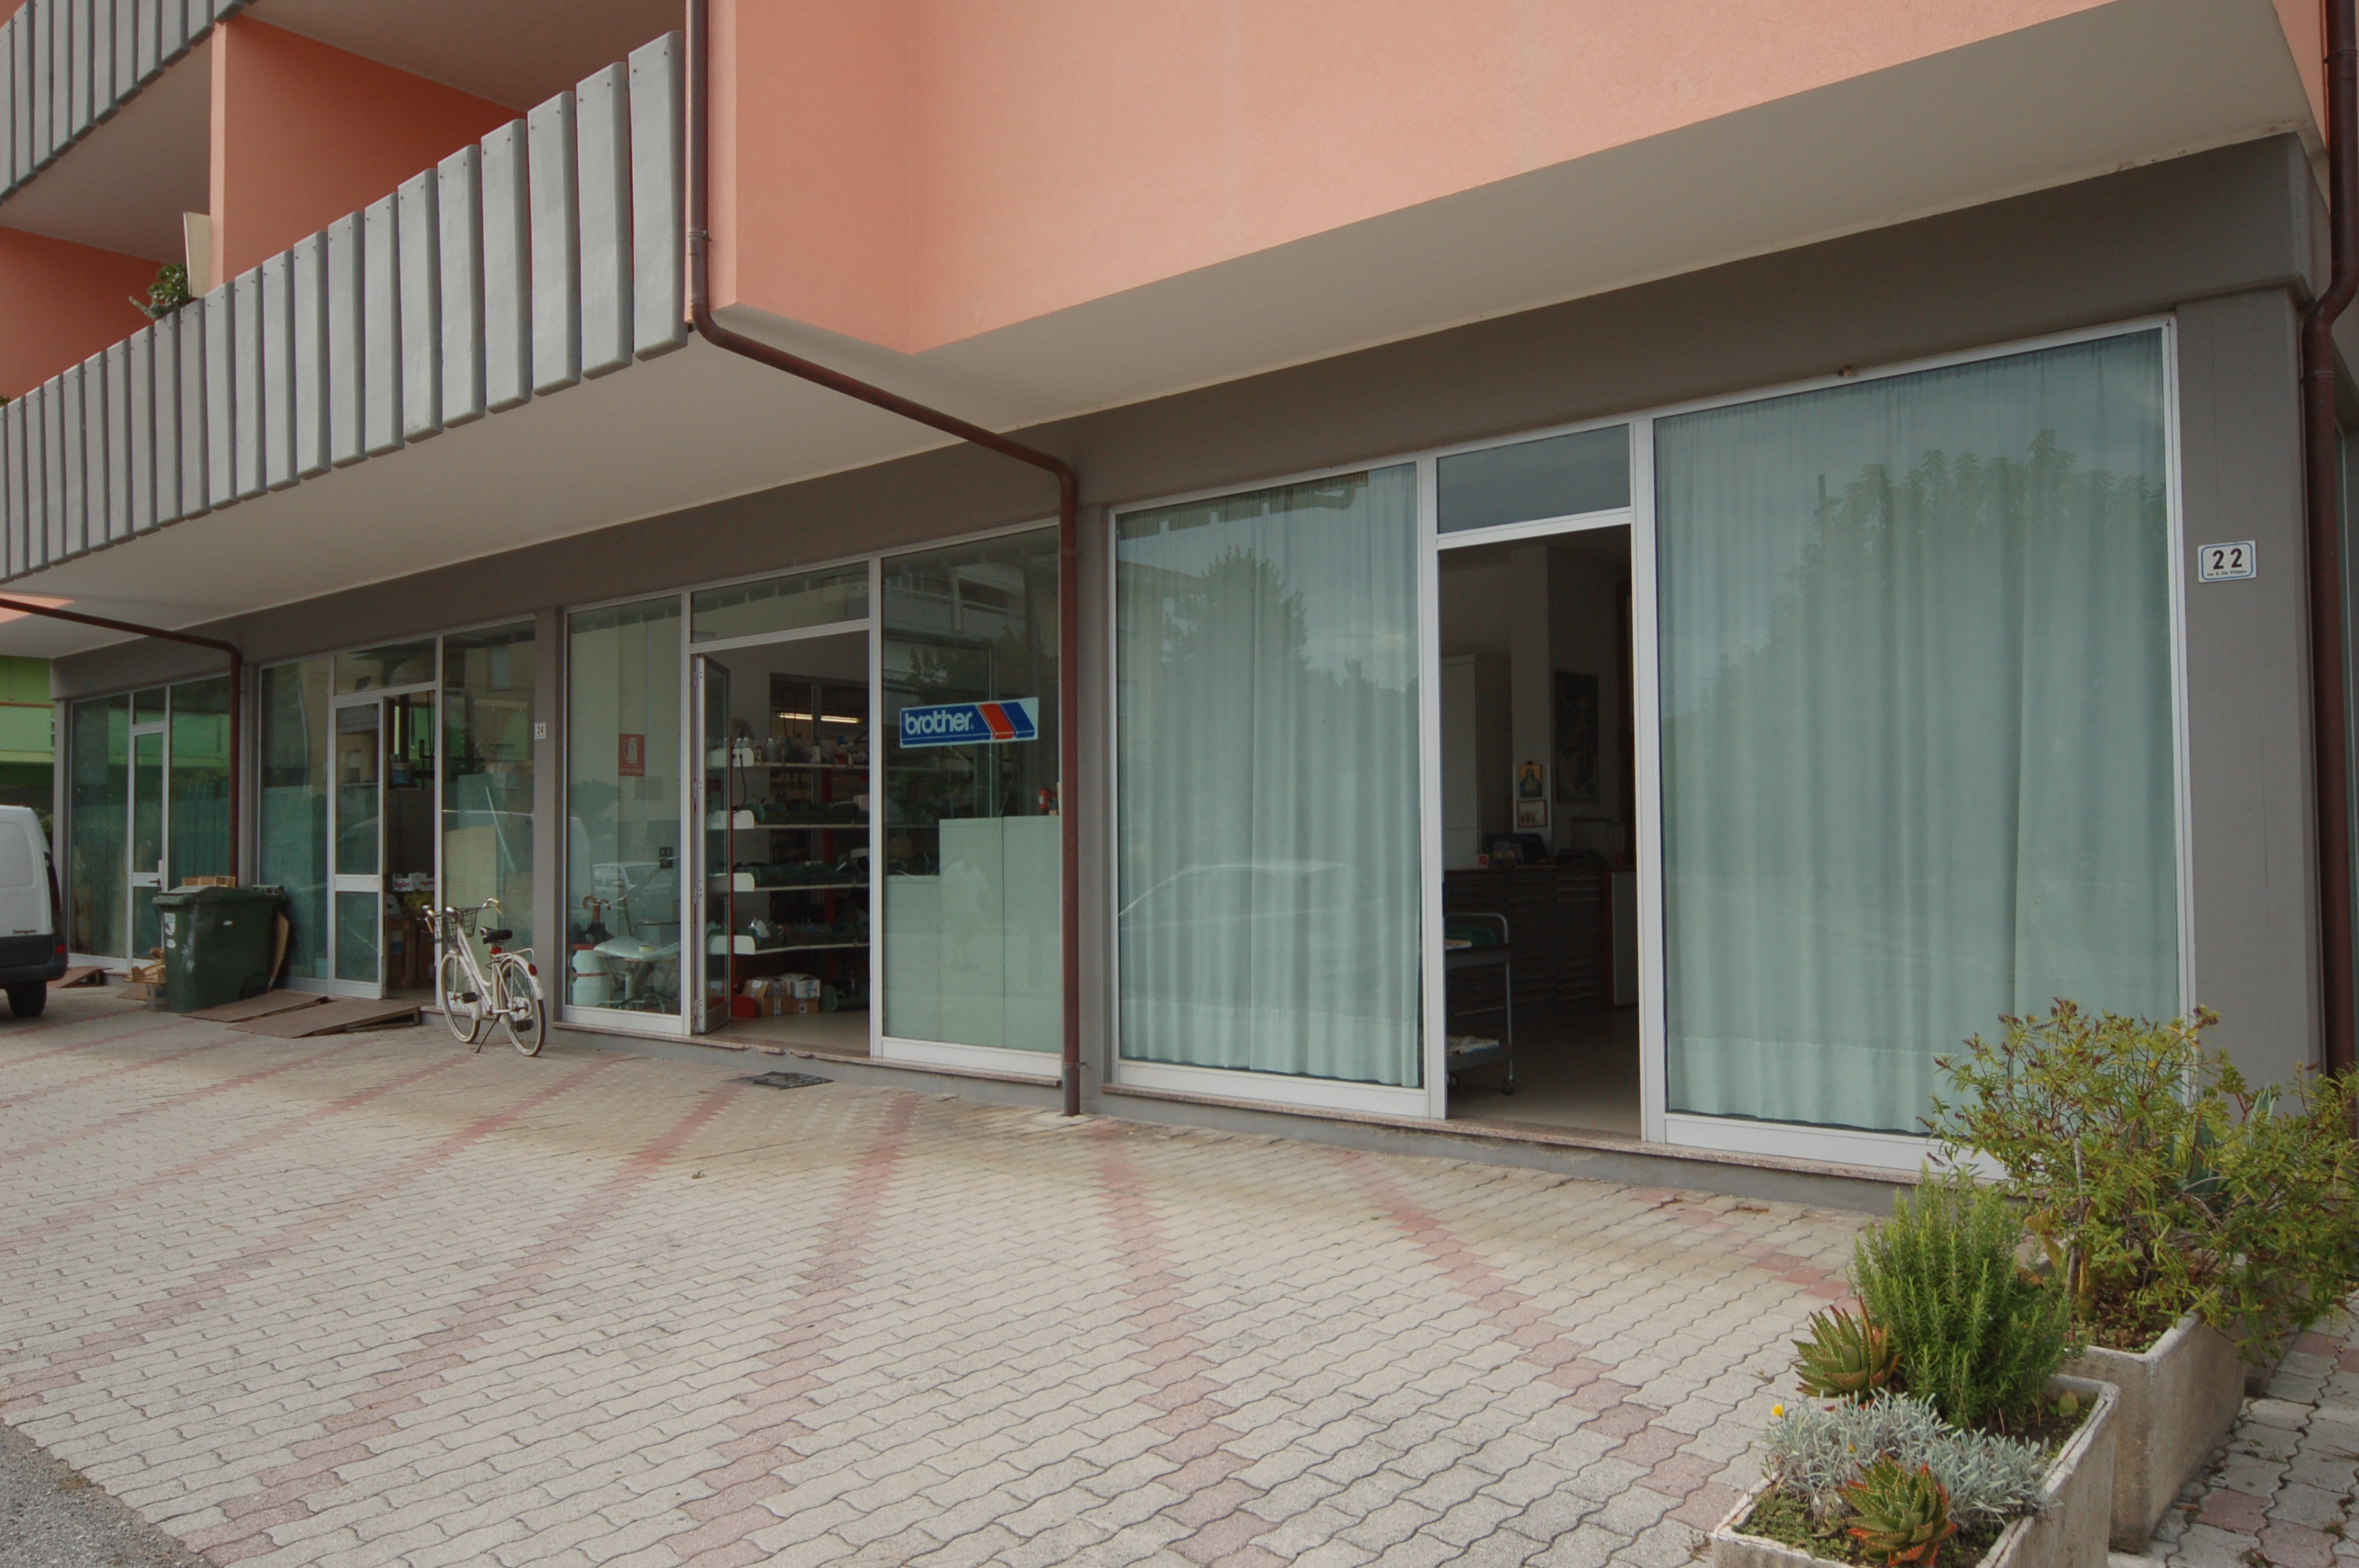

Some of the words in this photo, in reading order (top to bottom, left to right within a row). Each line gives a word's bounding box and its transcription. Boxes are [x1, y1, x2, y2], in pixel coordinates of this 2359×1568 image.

[2212, 548, 2243, 570] 22
[536, 724, 543, 735] 24
[905, 709, 973, 735] brother
